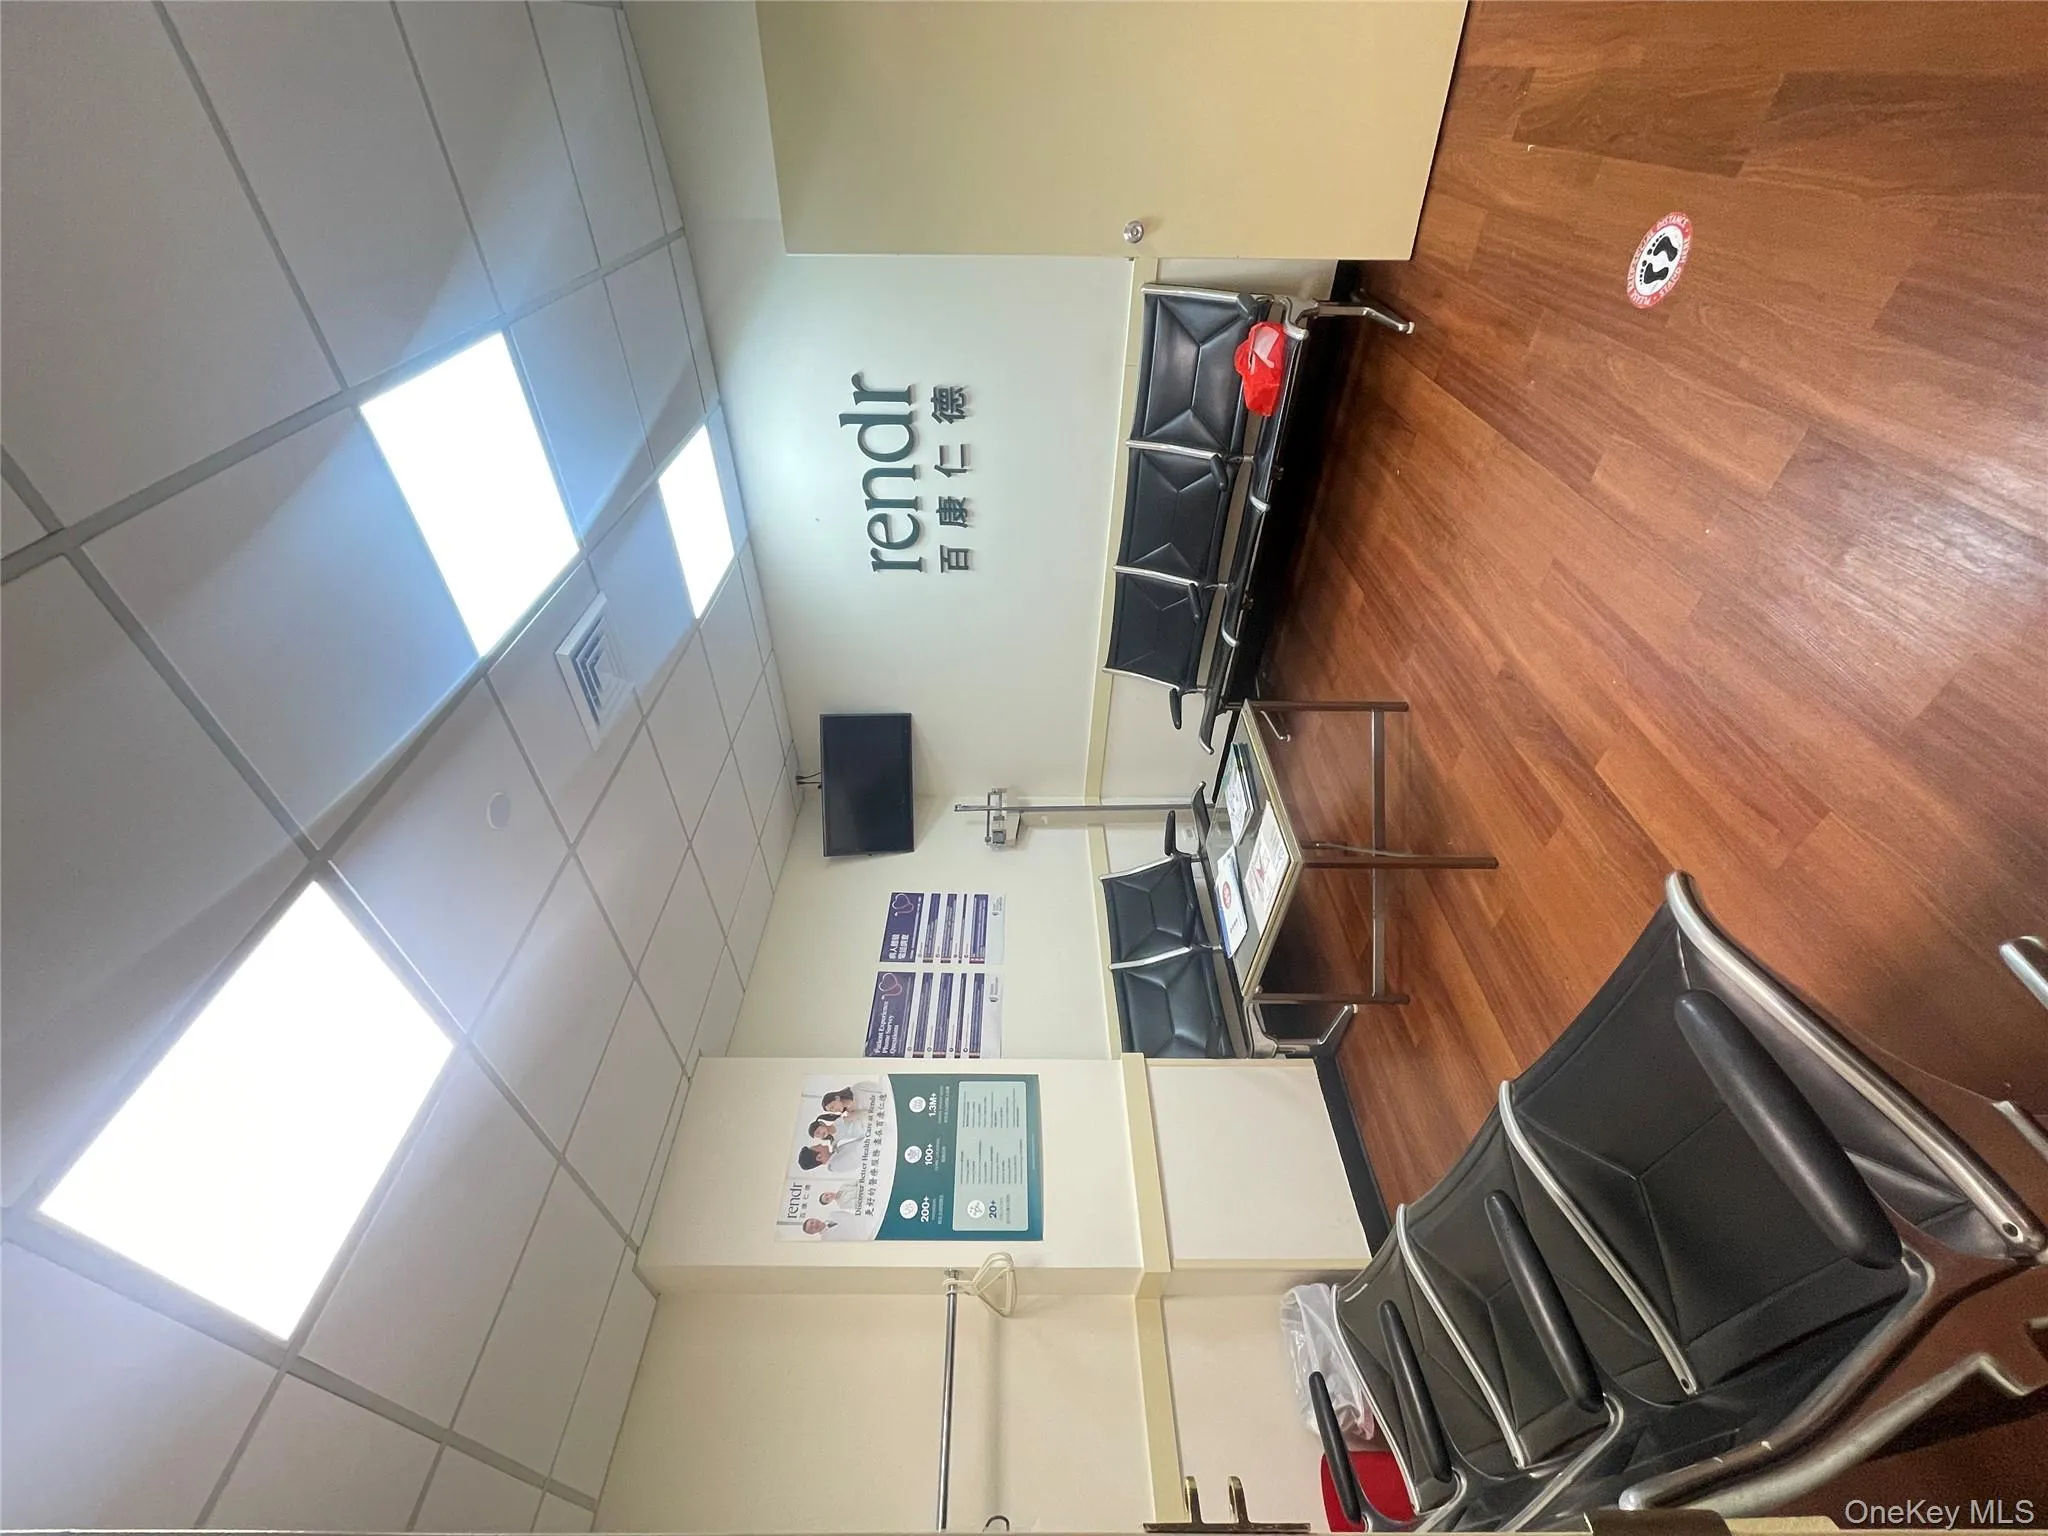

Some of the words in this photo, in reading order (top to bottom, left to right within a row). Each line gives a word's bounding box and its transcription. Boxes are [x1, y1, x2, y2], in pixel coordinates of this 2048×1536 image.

[837, 372, 923, 573] rendr
[930, 384, 970, 574] 百康仁德
[873, 1032, 884, 1053] Patient
[889, 1024, 899, 1054] Questions
[867, 1095, 876, 1114] Rendr
[928, 1092, 937, 1117] 1.3M+
[865, 1123, 873, 1137] Care
[862, 1138, 871, 1161] Health
[924, 1143, 934, 1165] 100+
[858, 1163, 868, 1183] Better
[787, 1181, 802, 1218] rendr
[855, 1185, 865, 1216] Discover
[920, 1196, 930, 1223] 200+
[988, 1200, 997, 1219] 20+
